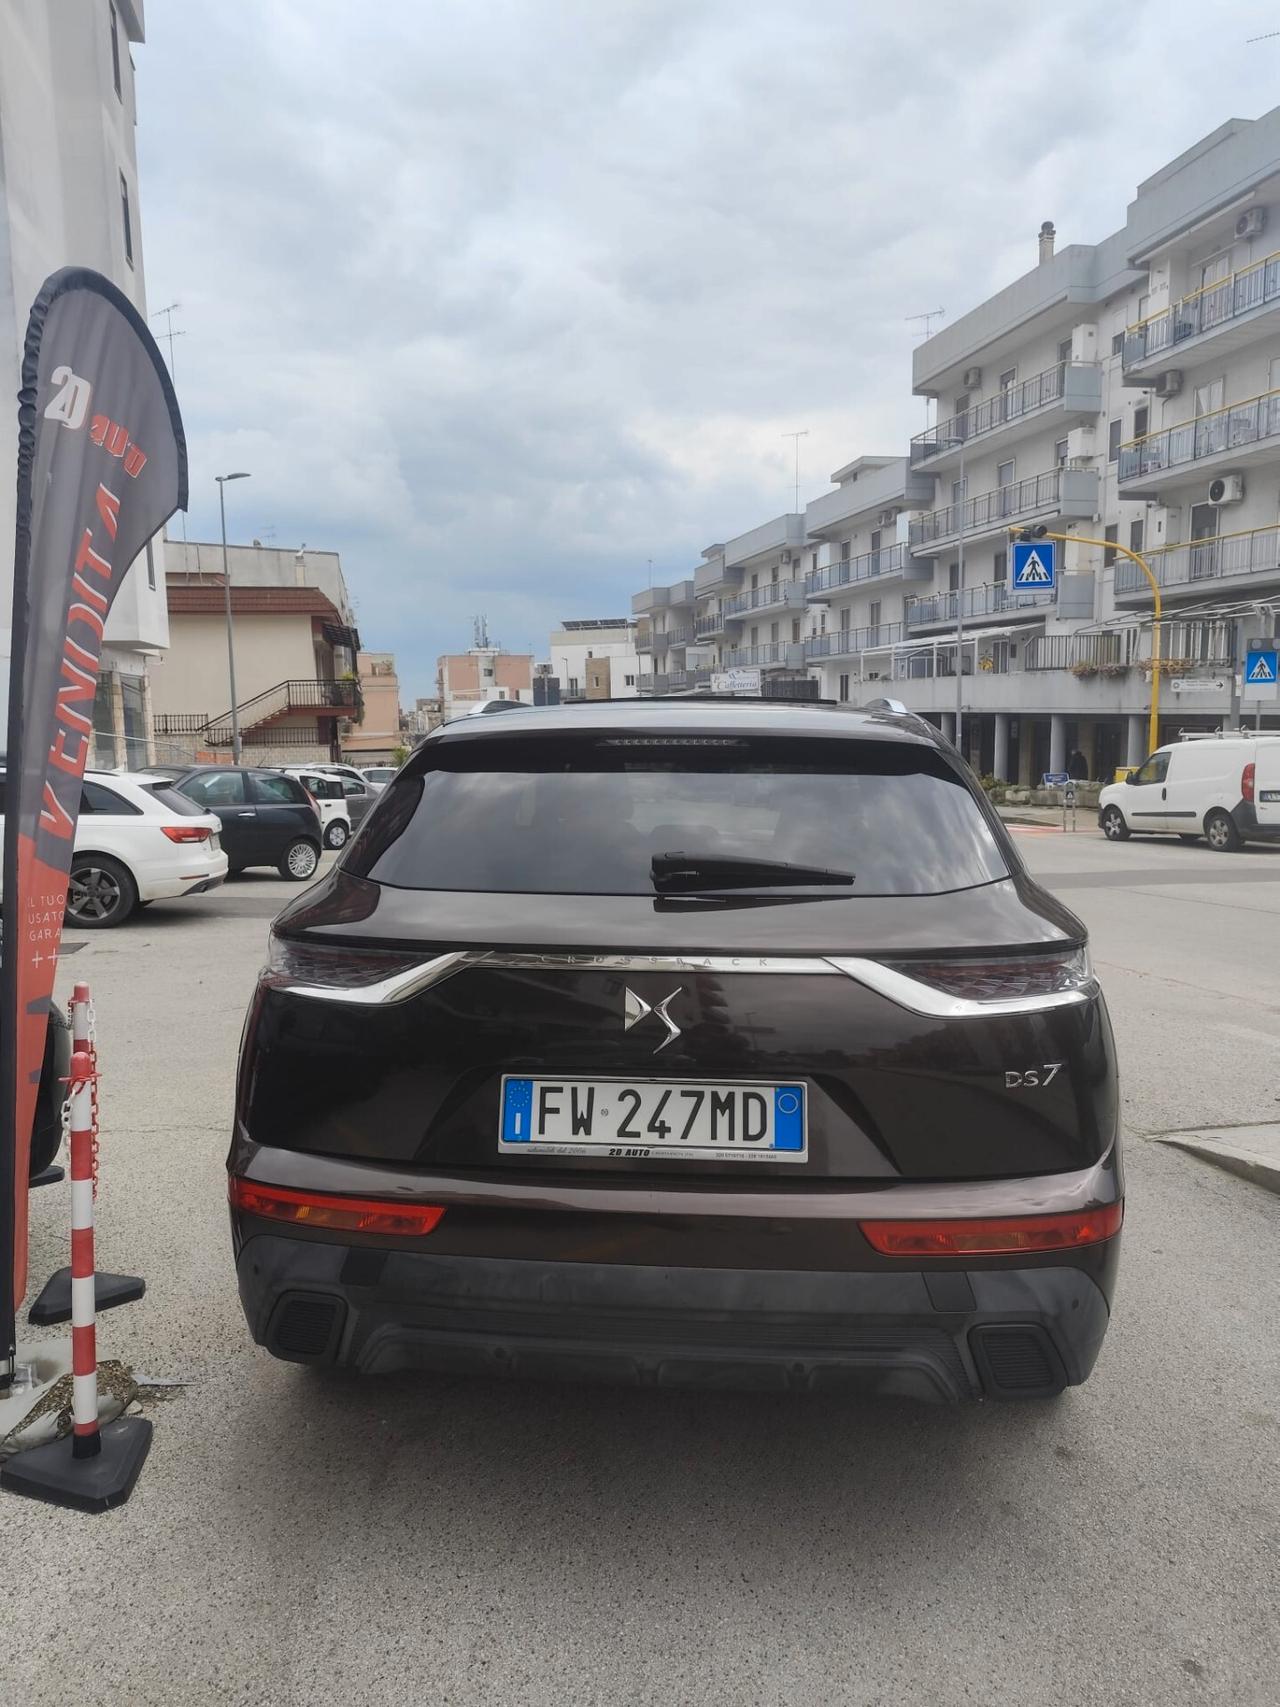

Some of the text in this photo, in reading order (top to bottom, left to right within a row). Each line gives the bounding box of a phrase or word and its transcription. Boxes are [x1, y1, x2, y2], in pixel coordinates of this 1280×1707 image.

[38, 482, 120, 840] VENDITA
[40, 894, 65, 906] TUO
[28, 910, 65, 925] USATO
[538, 1085, 595, 1137] FW
[616, 1088, 768, 1142] 247MD
[608, 1148, 622, 1157] 2D
[624, 1148, 651, 1158] AUTO
